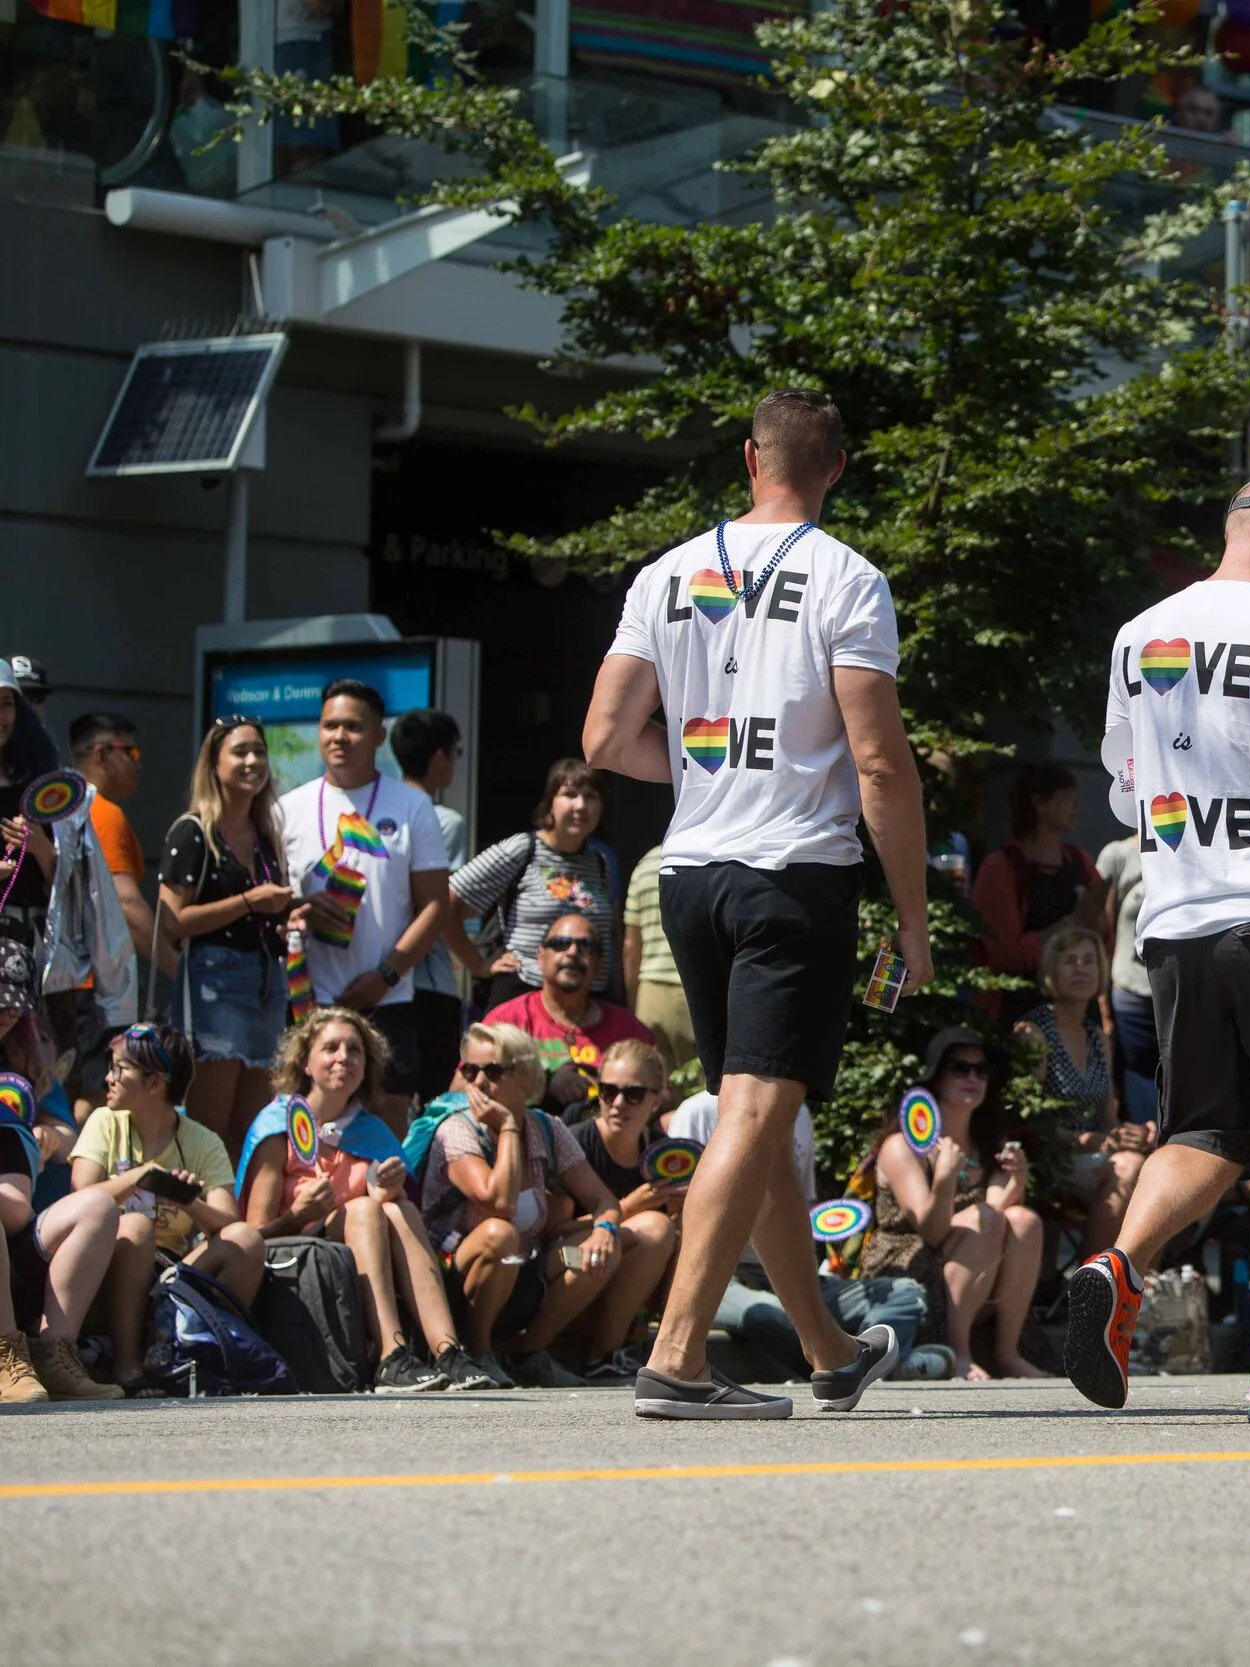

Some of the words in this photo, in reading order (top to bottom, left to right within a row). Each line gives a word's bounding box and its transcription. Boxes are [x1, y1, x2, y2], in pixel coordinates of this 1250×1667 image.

[409, 532, 510, 582] Parking
[724, 656, 739, 675] is
[679, 716, 776, 776] OVE
[1172, 732, 1193, 751] is
